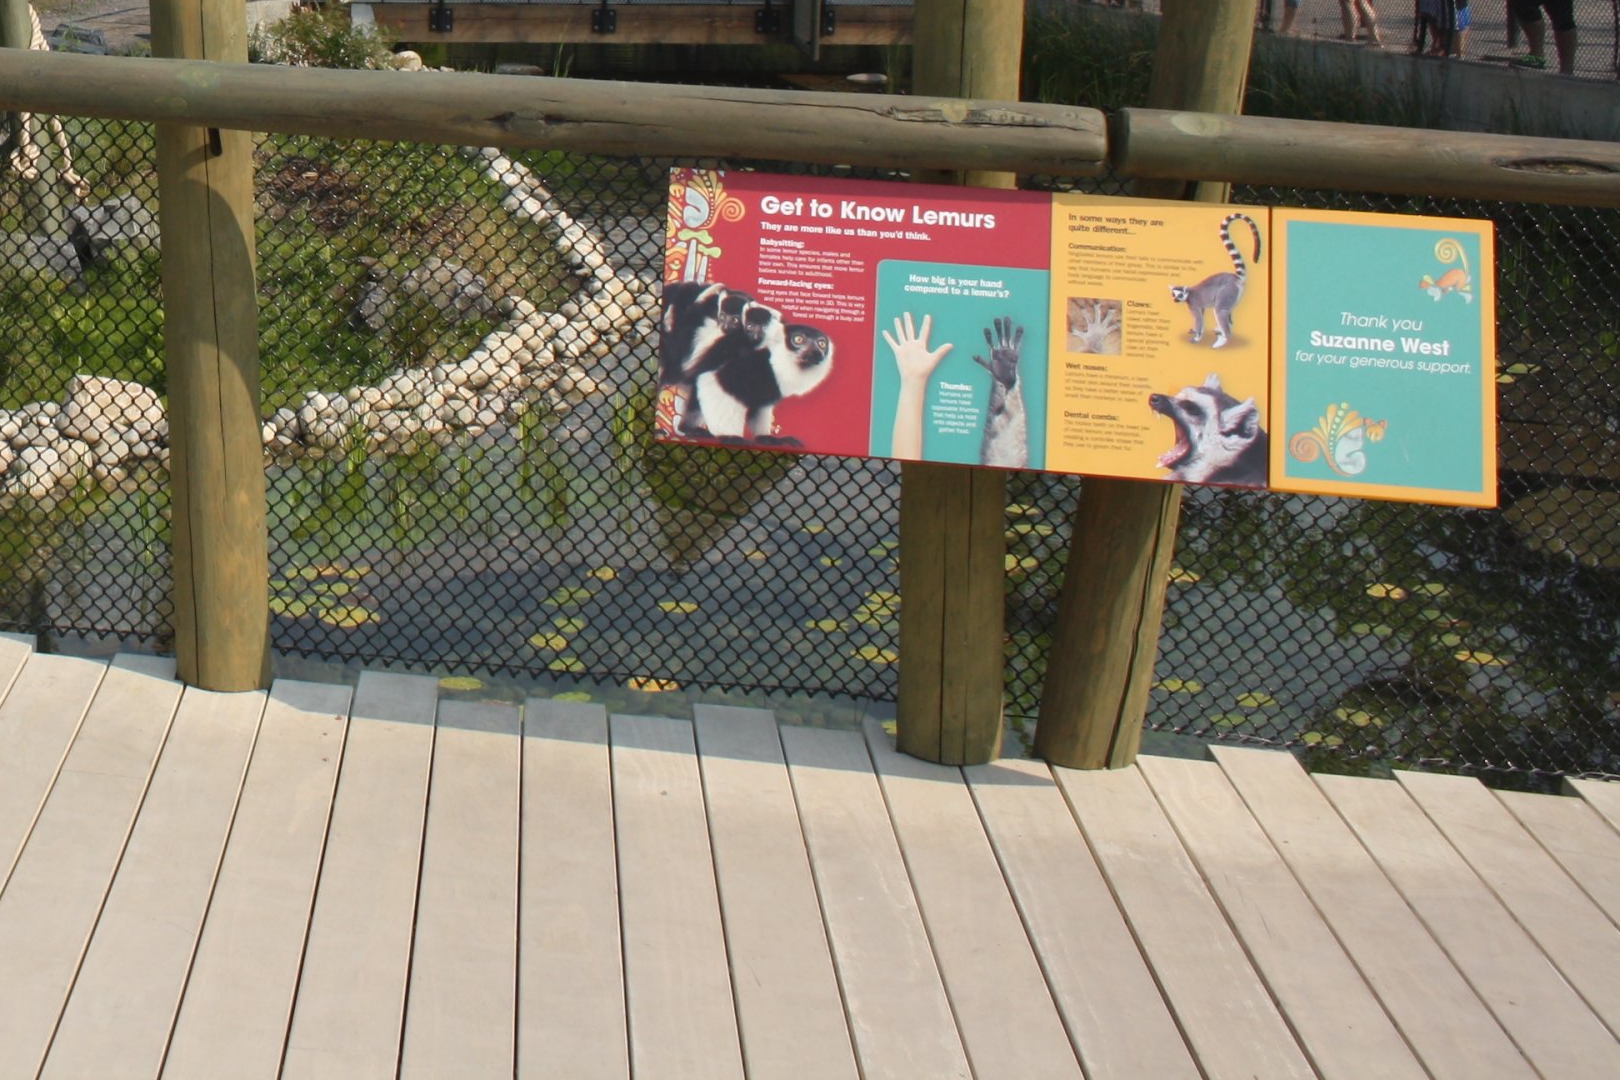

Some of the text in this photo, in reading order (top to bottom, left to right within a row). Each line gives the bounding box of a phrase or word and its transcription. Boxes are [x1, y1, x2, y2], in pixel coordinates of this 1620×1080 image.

[761, 196, 996, 229] Get to Know Lemurs
[1069, 213, 1076, 221] In
[1105, 216, 1127, 225] ways
[1129, 217, 1148, 226] they
[761, 222, 931, 241] They are more like us than you'd think.
[1069, 224, 1090, 232] quite
[760, 238, 805, 249] Babysitting:
[814, 282, 834, 290] eyes:
[909, 275, 1003, 288] How big is your hand
[904, 284, 948, 294] compared
[971, 288, 1010, 298] lemur's?
[1341, 312, 1422, 332] Thank you
[1310, 331, 1450, 356] Suzanne West
[1295, 350, 1471, 374] for your generous support.
[1064, 411, 1089, 419] Dental
